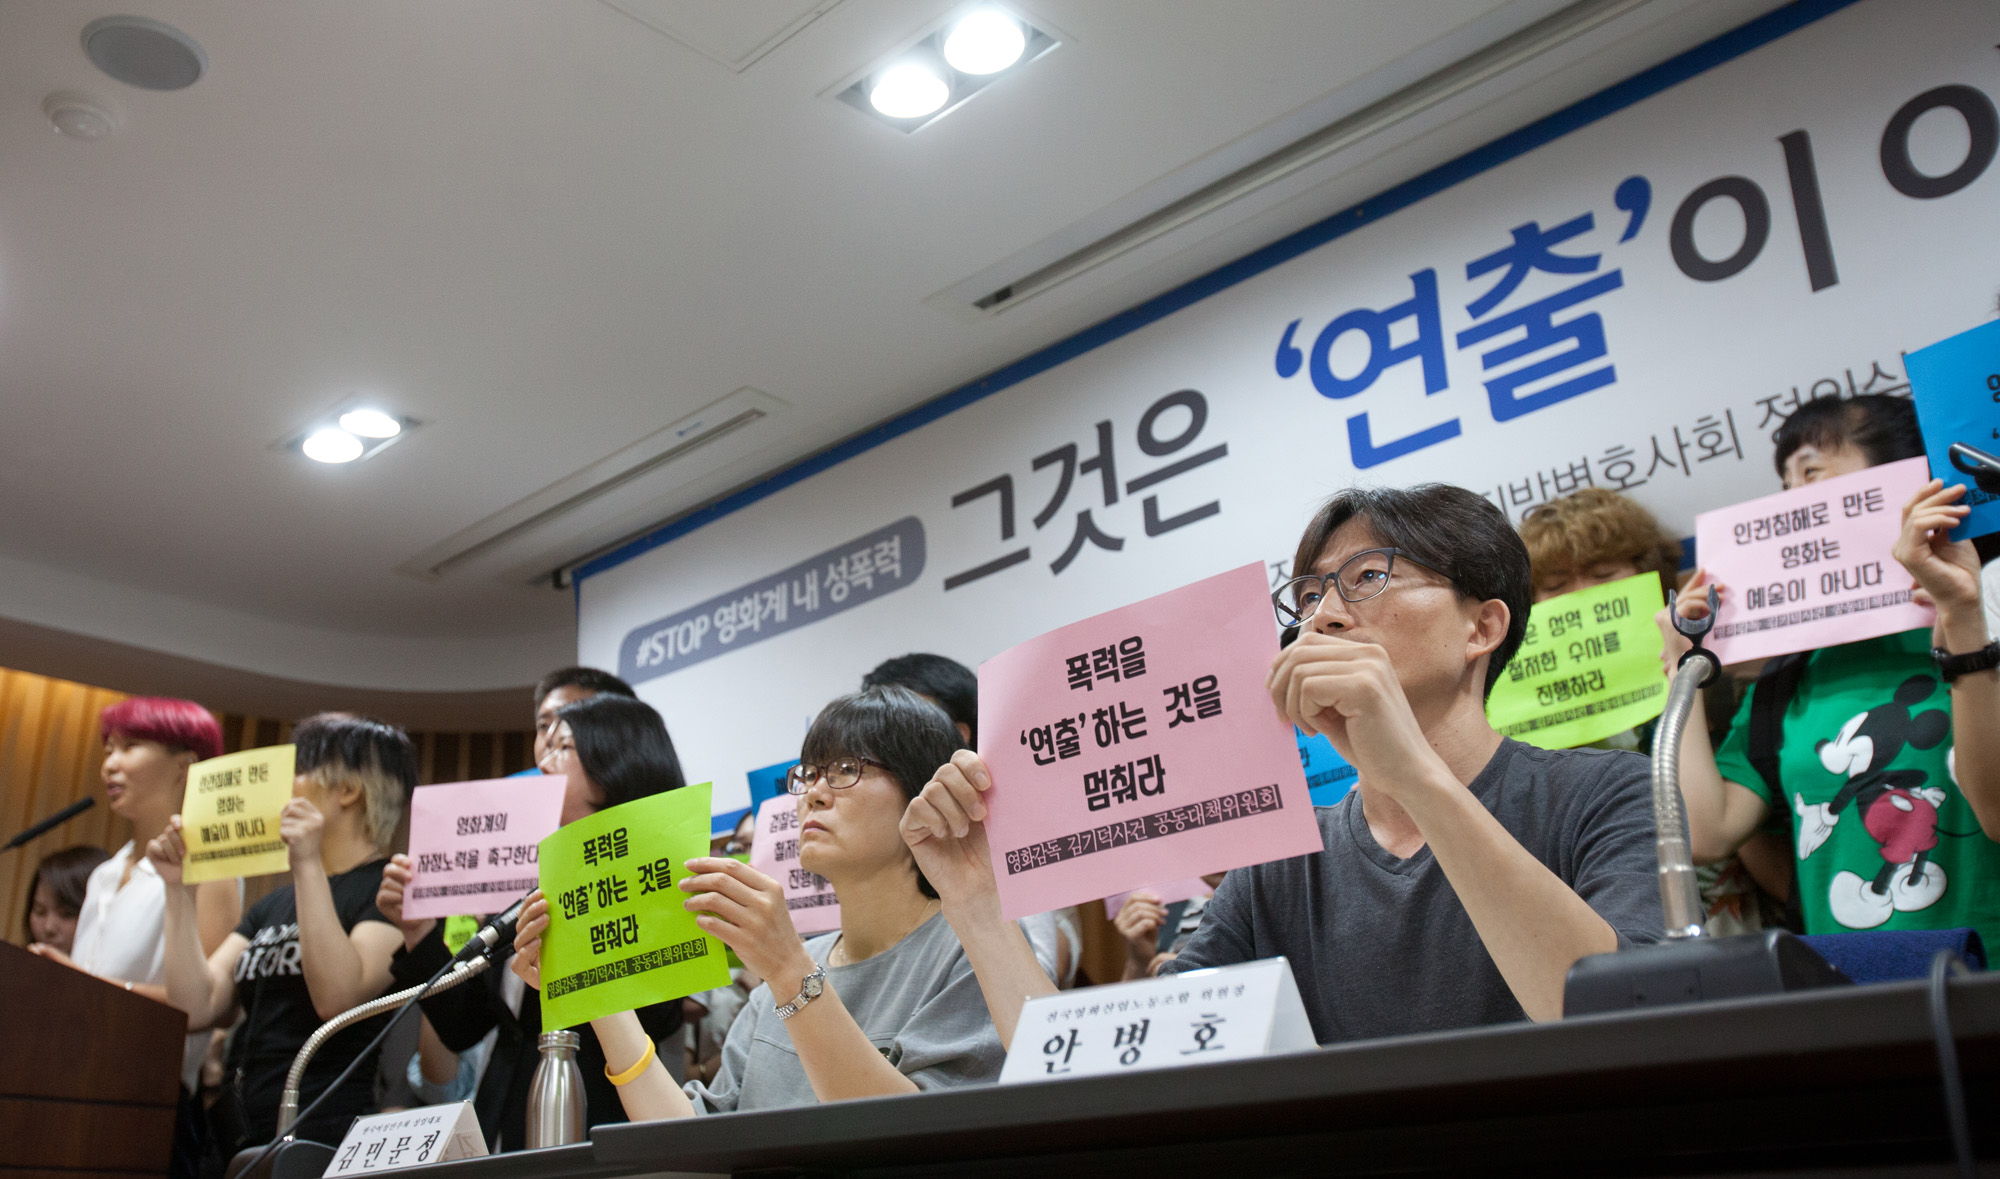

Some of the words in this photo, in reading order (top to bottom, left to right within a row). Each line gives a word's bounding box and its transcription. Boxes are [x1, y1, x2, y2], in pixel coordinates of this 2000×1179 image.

[944, 388, 1228, 592] 그것은
[1734, 501, 1830, 546] 인권침해로
[1843, 486, 1885, 519] 만든
[1781, 537, 1841, 570] 영화는
[636, 614, 710, 669] #STOP
[713, 581, 788, 645] 영화계
[792, 568, 820, 612] 내
[823, 534, 902, 603] 성폭력
[1746, 578, 1806, 611] 예술이
[1820, 561, 1885, 597] 아니다
[1548, 609, 1583, 638] 성역
[1593, 597, 1631, 624] 없이
[1065, 636, 1147, 692] 폭력을
[1569, 630, 1621, 664] 수사를
[1536, 670, 1606, 707] 진행하라
[1020, 701, 1148, 766] ‘연출’하는
[1163, 674, 1223, 729] 것을
[1083, 754, 1166, 812] 멈춰라
[235, 817, 266, 838] 아니다
[456, 813, 508, 836] 영화계의
[583, 827, 629, 866] 폭력을
[1007, 839, 1062, 873] 영화감독
[1067, 817, 1147, 857] 김기덕사건
[1154, 785, 1280, 834] 공동대책위원회
[417, 850, 480, 874] 자정노력을
[558, 874, 629, 920] ‘연출’하는
[637, 857, 672, 896] 것을
[590, 914, 639, 955] 멈춰라
[547, 976, 579, 999] 영화감독
[581, 960, 629, 986] 김기덕사건
[631, 938, 708, 973] 공동대책위원회
[338, 1130, 441, 1172] 김민문정
